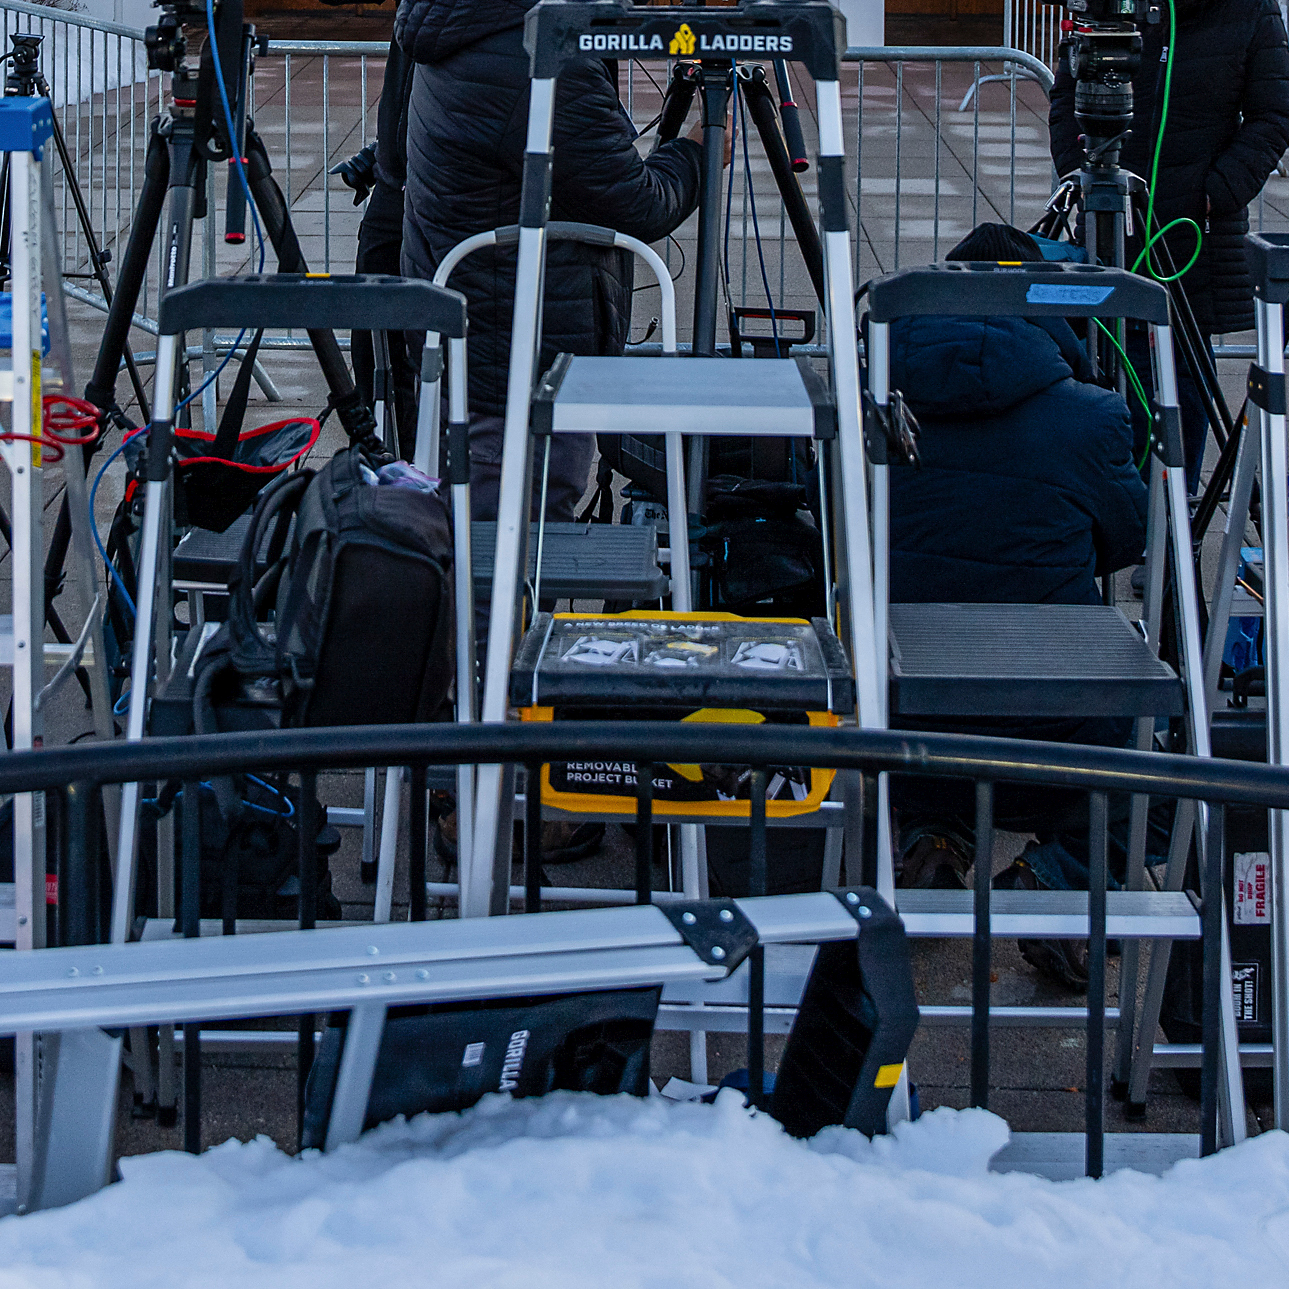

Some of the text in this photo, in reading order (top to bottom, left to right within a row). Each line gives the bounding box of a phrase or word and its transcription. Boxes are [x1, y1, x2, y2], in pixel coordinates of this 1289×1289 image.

[579, 34, 793, 52] GORILLA LADDERS
[567, 762, 638, 773] REMOVABL
[567, 772, 622, 783] PROJECT
[1255, 864, 1266, 917] FRAGILE
[1243, 980, 1253, 1020] THE SHOT!
[499, 1029, 530, 1091] GORILLA
